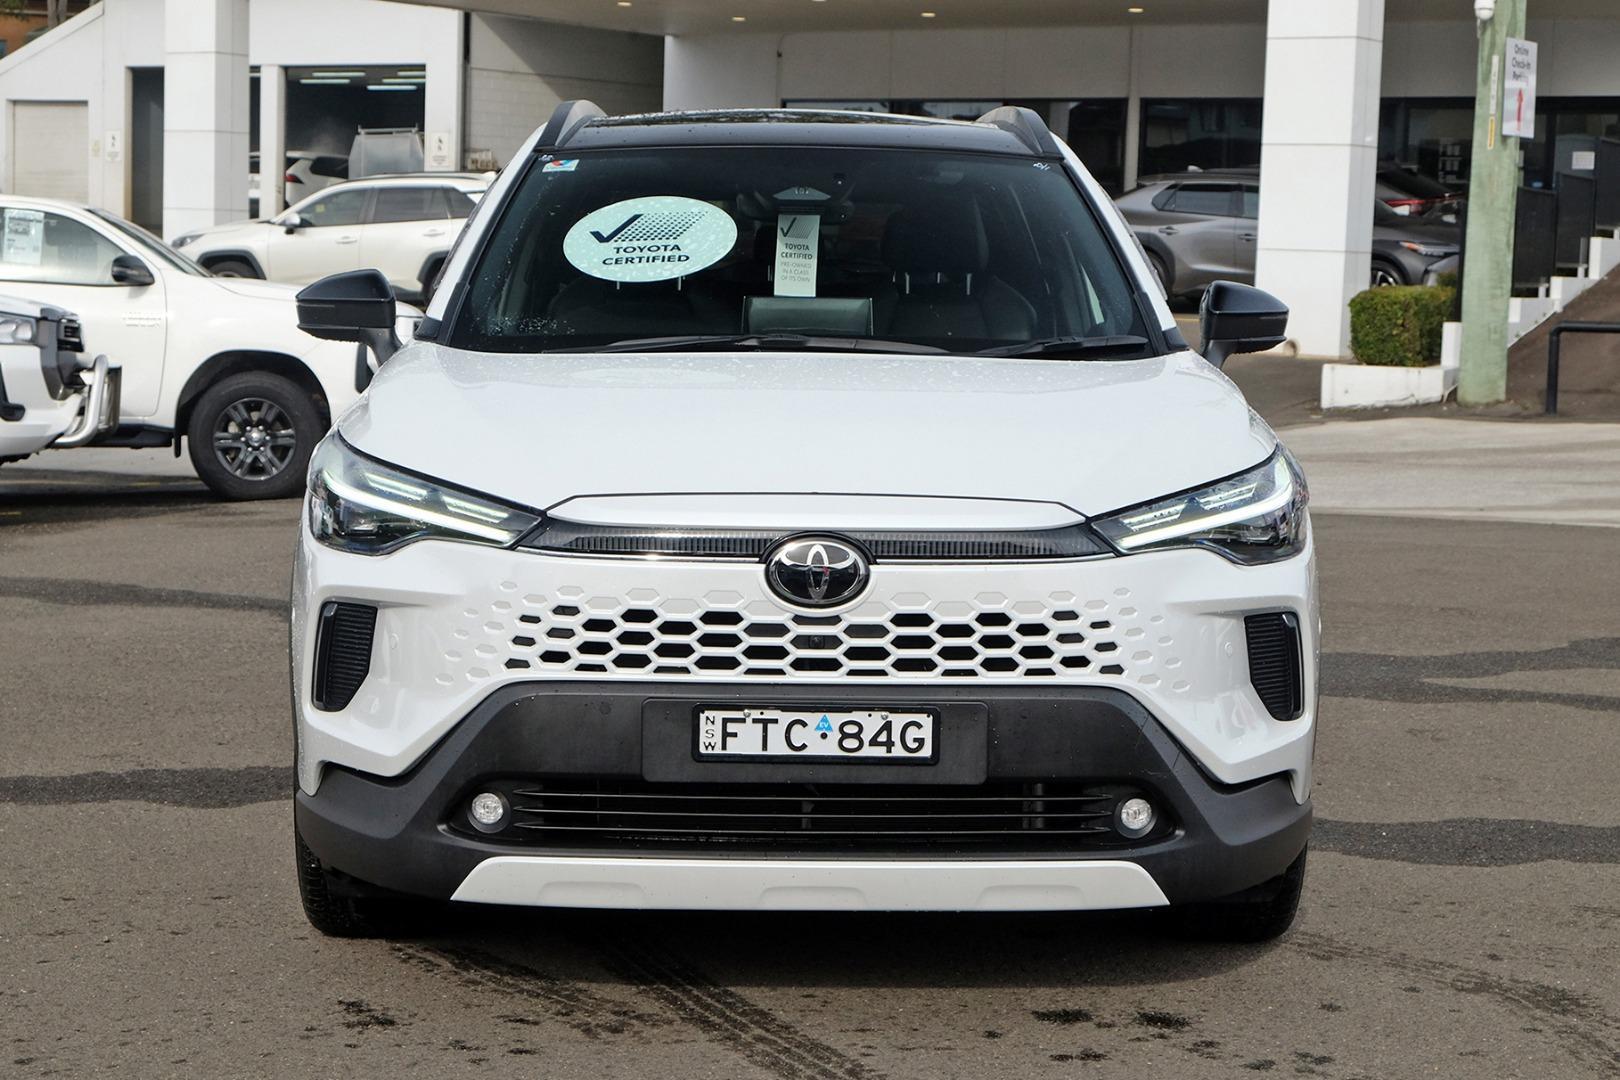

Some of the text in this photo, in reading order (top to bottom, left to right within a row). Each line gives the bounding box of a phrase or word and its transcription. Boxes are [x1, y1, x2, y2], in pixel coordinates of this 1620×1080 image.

[613, 244, 682, 254] TOYOTA
[785, 242, 810, 251] TOYOTA
[602, 254, 690, 266] CERTIFIED
[780, 251, 813, 260] CERTIFIED
[819, 720, 830, 728] EV
[721, 717, 925, 754] FTC 84G
